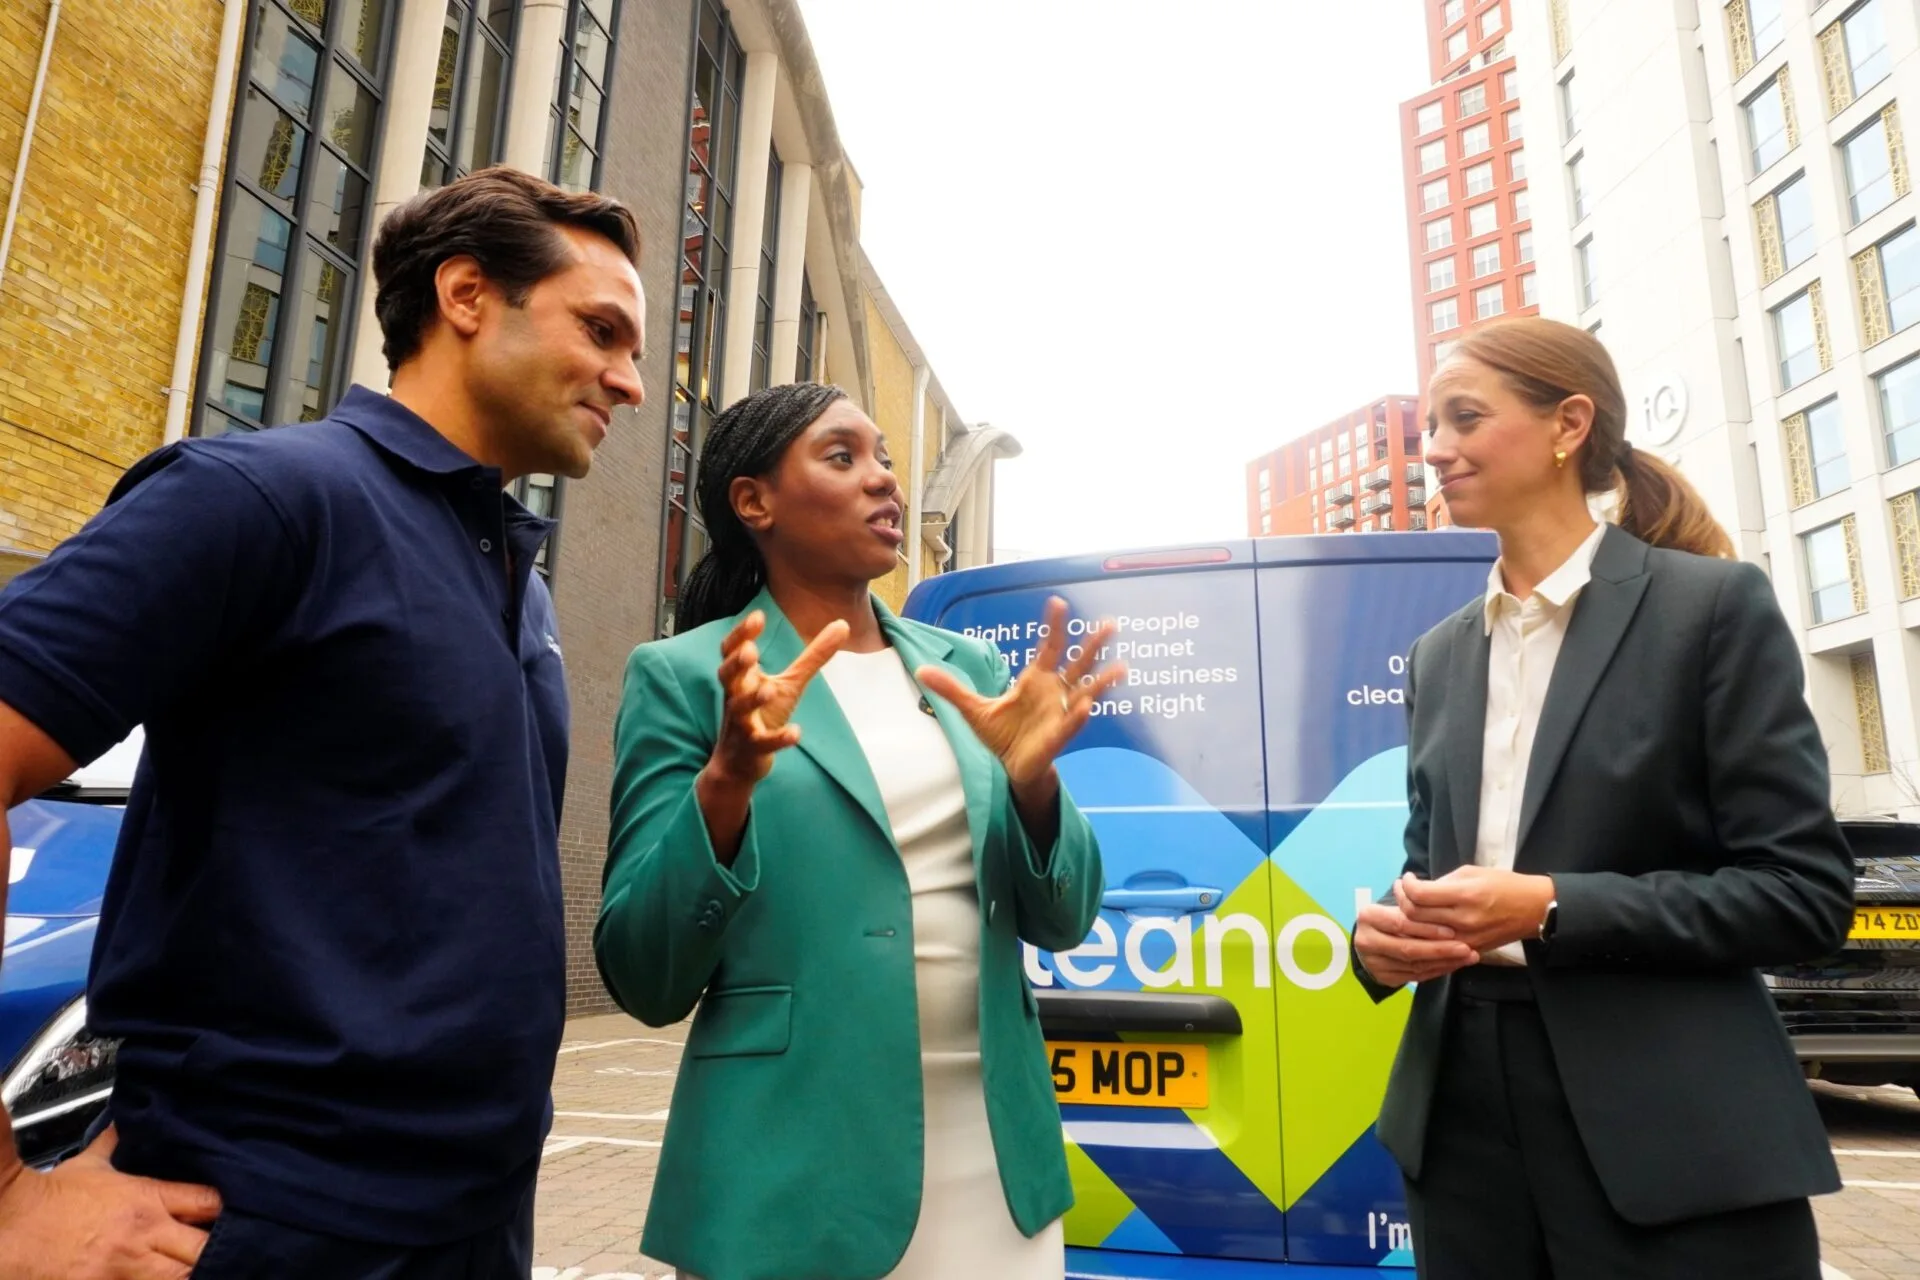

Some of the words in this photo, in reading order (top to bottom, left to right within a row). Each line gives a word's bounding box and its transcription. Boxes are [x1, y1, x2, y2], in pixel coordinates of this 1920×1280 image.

[963, 623, 1020, 643] Right
[1026, 621, 1051, 639] Fo
[1117, 612, 1200, 635] People
[1066, 645, 1110, 662] Or
[1117, 639, 1195, 660] Planet
[1127, 665, 1238, 686] Business
[1388, 655, 1409, 675] 0
[1088, 699, 1133, 717] one
[1140, 693, 1206, 719] Right
[1852, 913, 1886, 931] 74
[1889, 913, 1920, 931] ZD
[1092, 1049, 1185, 1097] MOP
